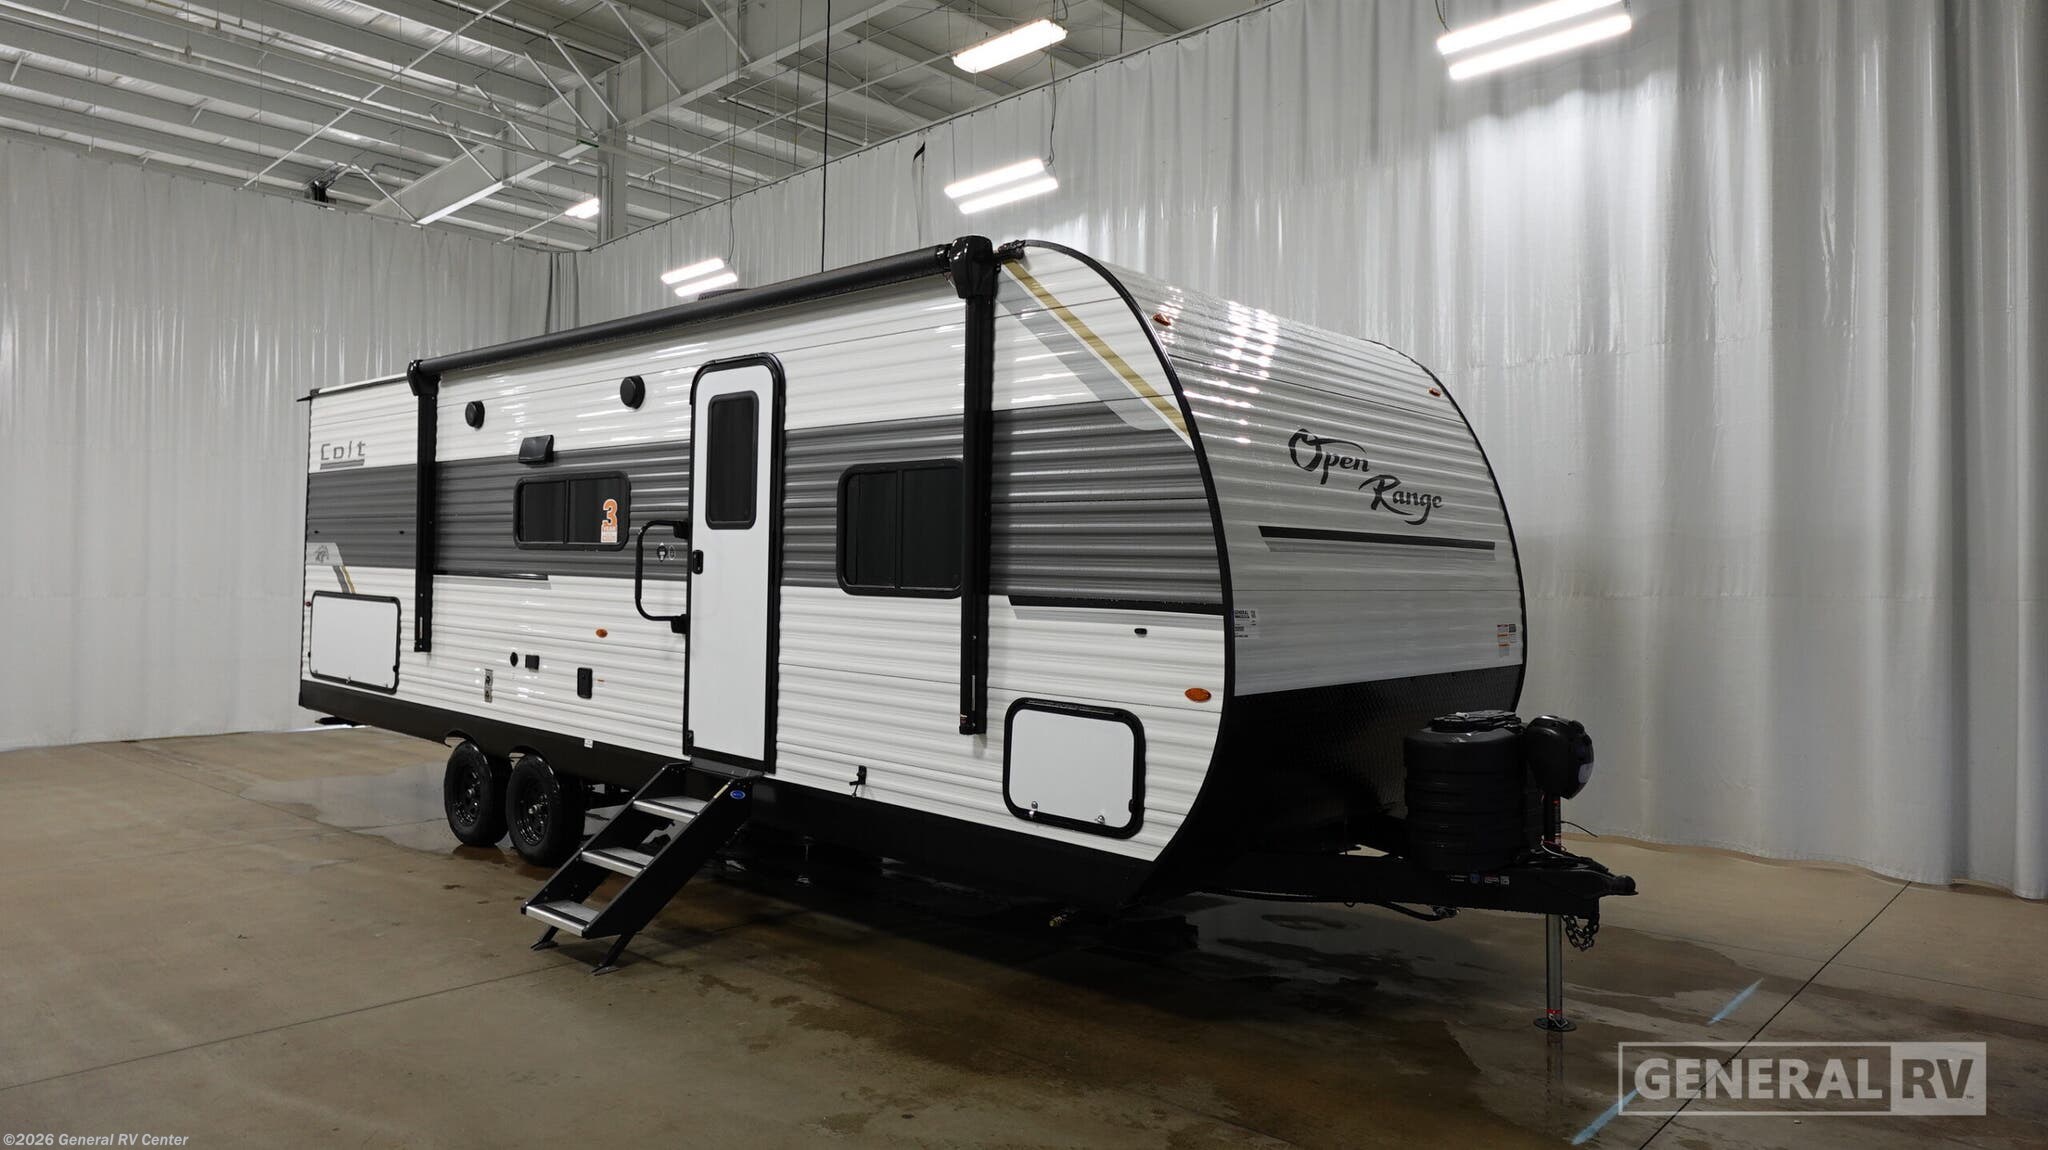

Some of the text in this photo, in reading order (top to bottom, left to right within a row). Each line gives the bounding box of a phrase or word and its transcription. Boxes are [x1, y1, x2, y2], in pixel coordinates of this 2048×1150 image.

[320, 440, 366, 461] Colt
[1288, 428, 1370, 485] Open
[602, 498, 618, 527] 3
[1358, 474, 1443, 526] Range
